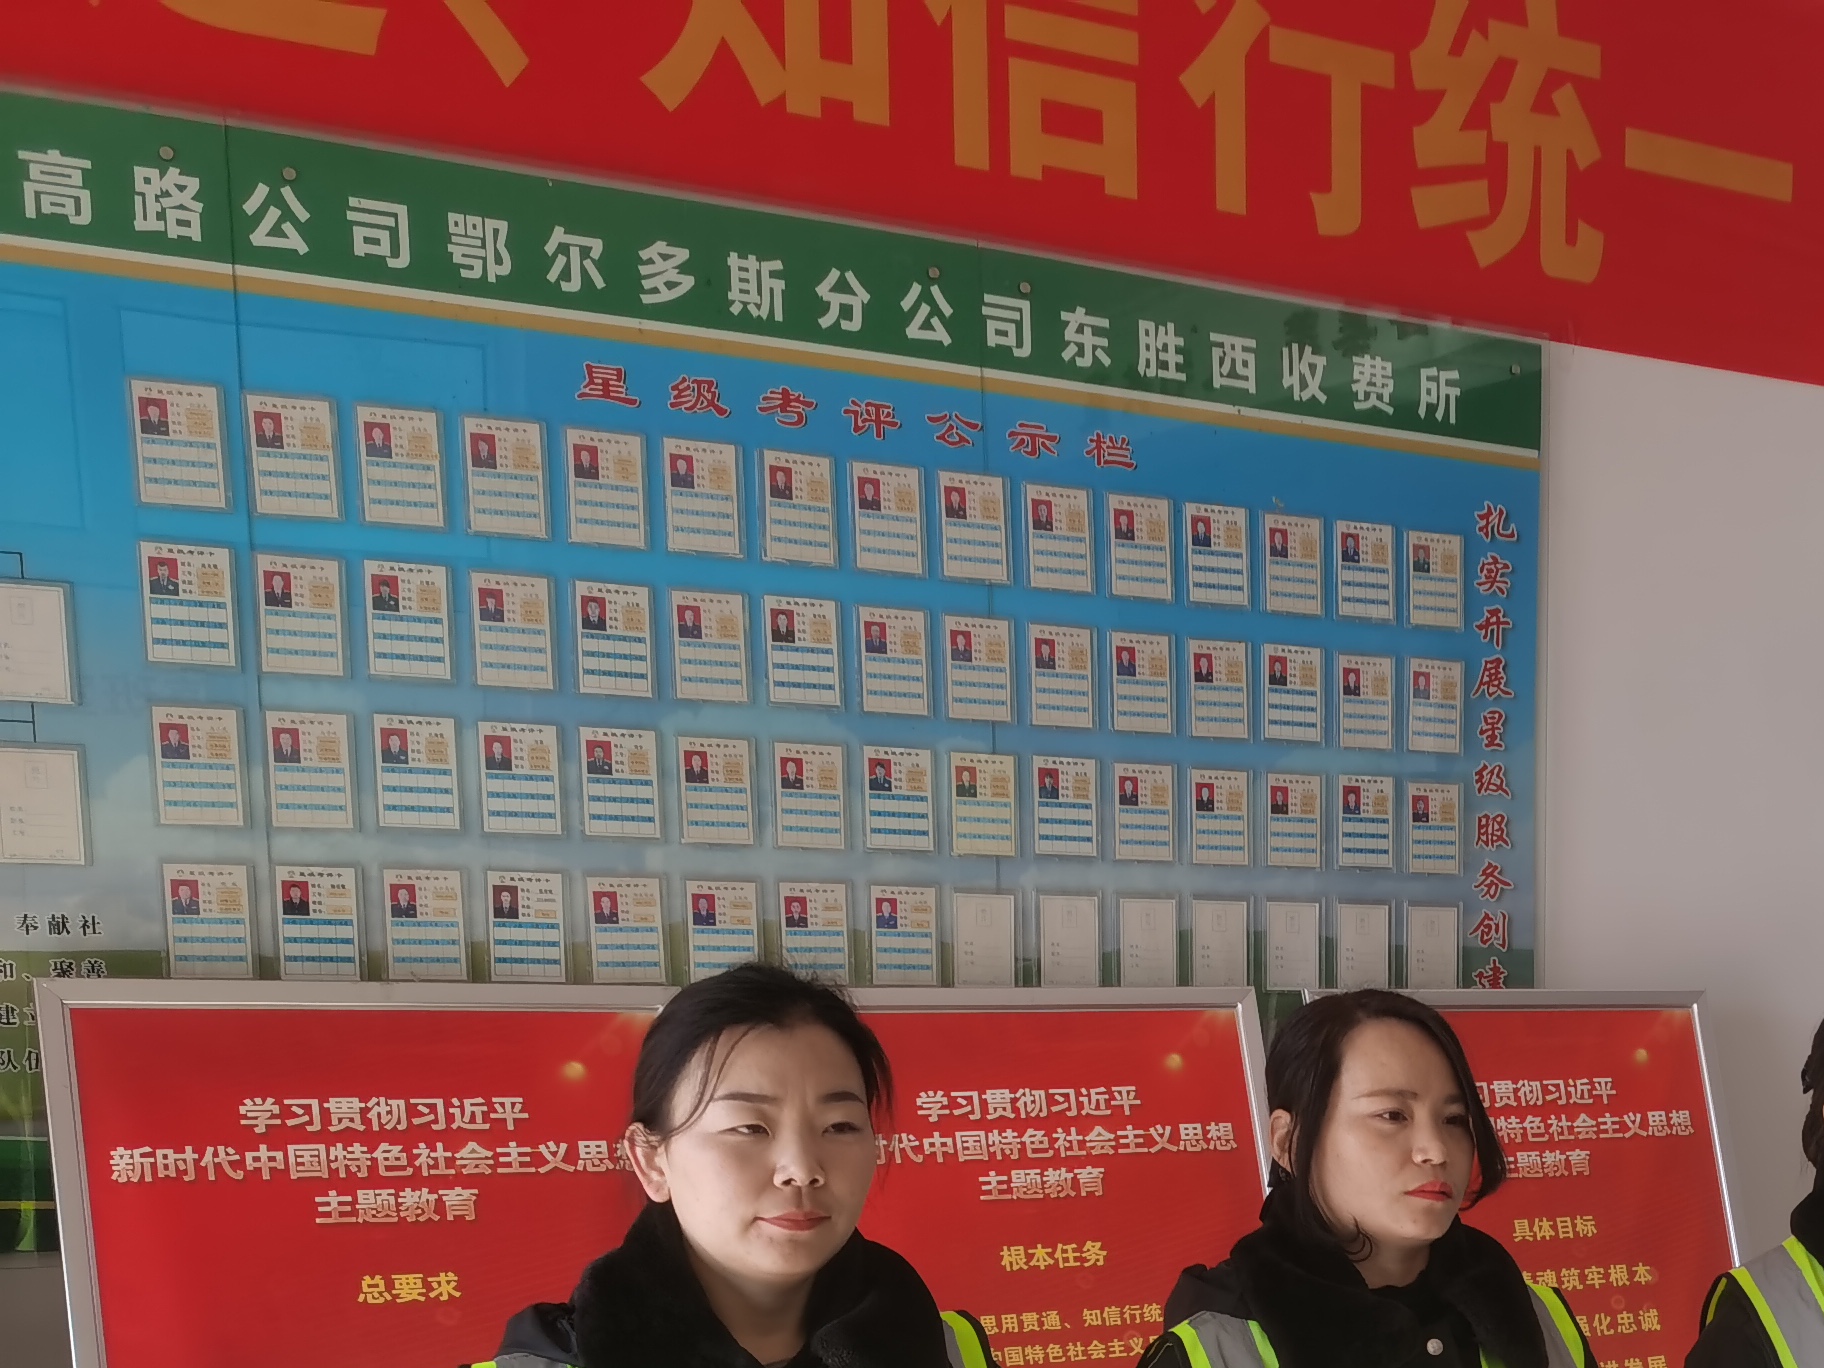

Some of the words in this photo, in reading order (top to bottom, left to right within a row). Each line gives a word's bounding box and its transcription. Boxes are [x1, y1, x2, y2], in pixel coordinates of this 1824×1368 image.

[15, 149, 1462, 425] 高路公司鄂尔多斯分公司东胜西收费所
[576, 361, 1137, 471] 星级考评公示栏
[16, 914, 102, 936] 奉献社
[239, 1096, 529, 1133] 学习贯彻习近平
[916, 1086, 1142, 1122] 学习贯彻习近平
[1489, 1109, 1695, 1144] 特色社会主义思想
[979, 1167, 1106, 1201] 主题教育
[314, 1188, 479, 1225] 主题教育
[1513, 1215, 1598, 1243] 具体目标
[1001, 1241, 1108, 1272] 根本任务
[358, 1272, 461, 1303] 总要求
